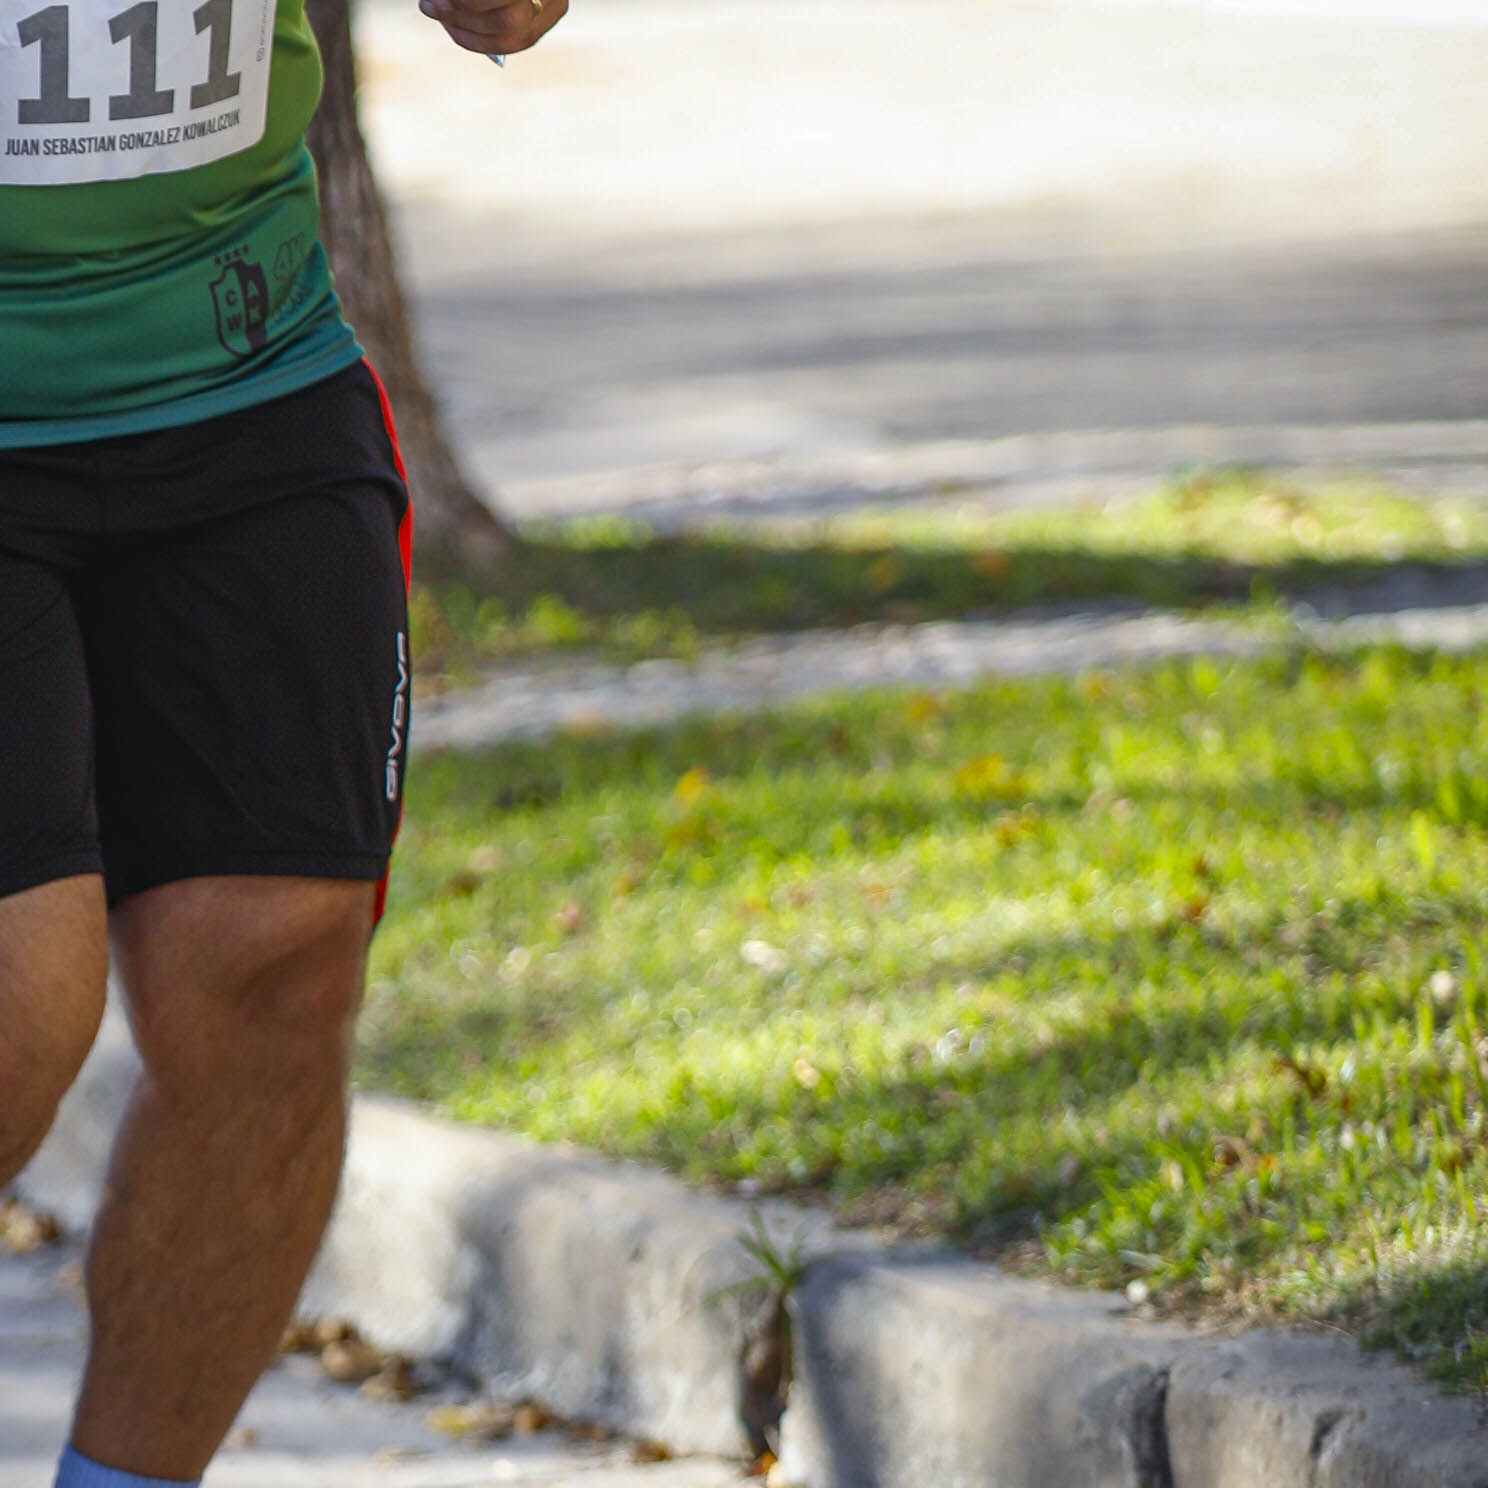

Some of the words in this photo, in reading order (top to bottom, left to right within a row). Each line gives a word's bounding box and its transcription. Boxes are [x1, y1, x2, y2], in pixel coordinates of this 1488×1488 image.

[5, 138, 39, 156] JUAN
[43, 135, 116, 155] SEBASTIAN
[119, 126, 180, 151] GONZALEZ
[182, 109, 240, 141] KOWALCZUK
